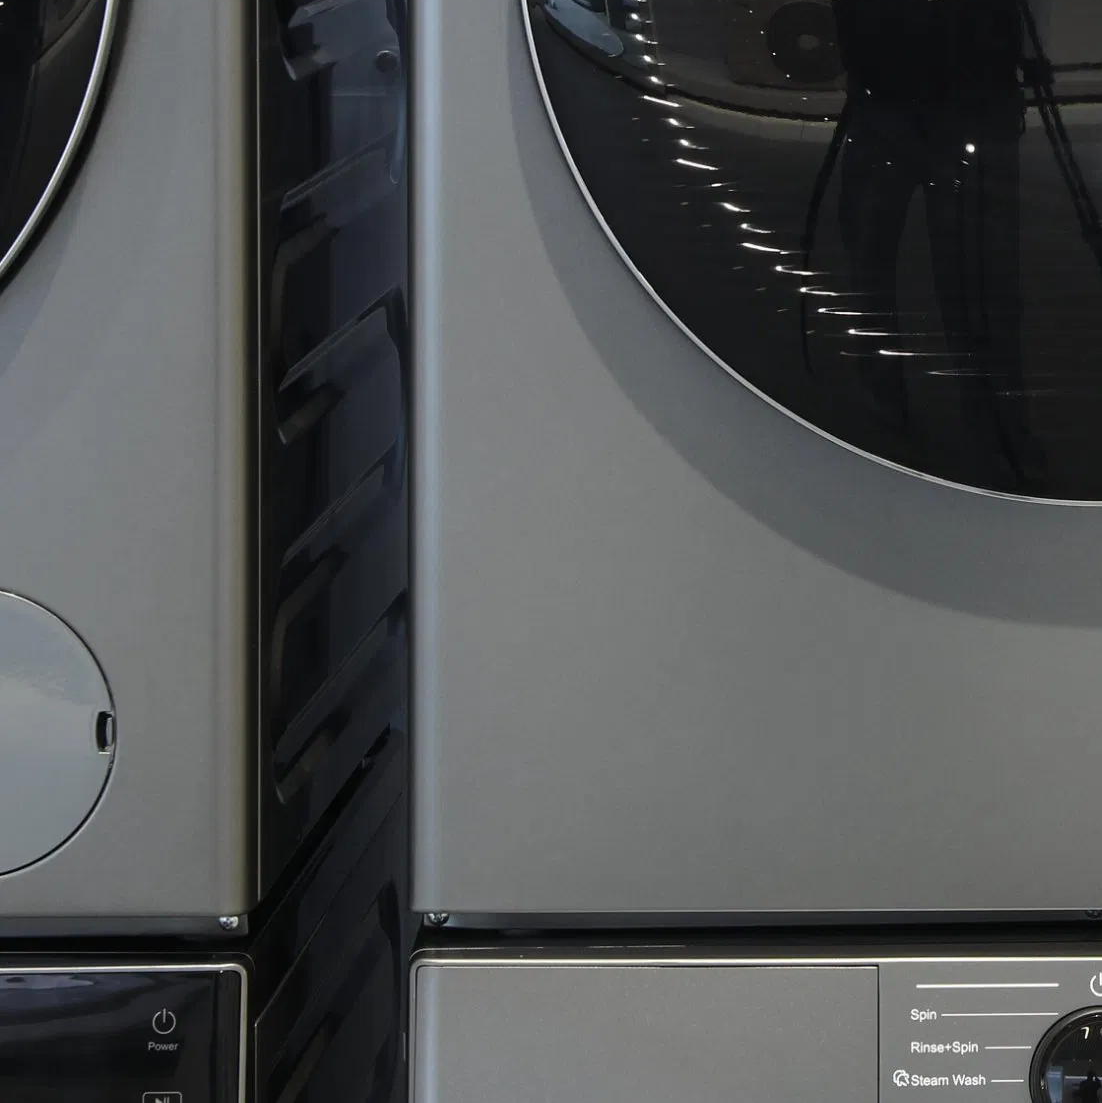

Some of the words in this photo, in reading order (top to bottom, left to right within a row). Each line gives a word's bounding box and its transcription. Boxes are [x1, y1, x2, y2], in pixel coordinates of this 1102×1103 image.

[910, 1009, 937, 1021] Spin
[148, 1042, 178, 1051] Power
[910, 1041, 979, 1054] Rinse+Spin
[910, 1074, 950, 1086] Steam
[952, 1074, 986, 1086] Wash
